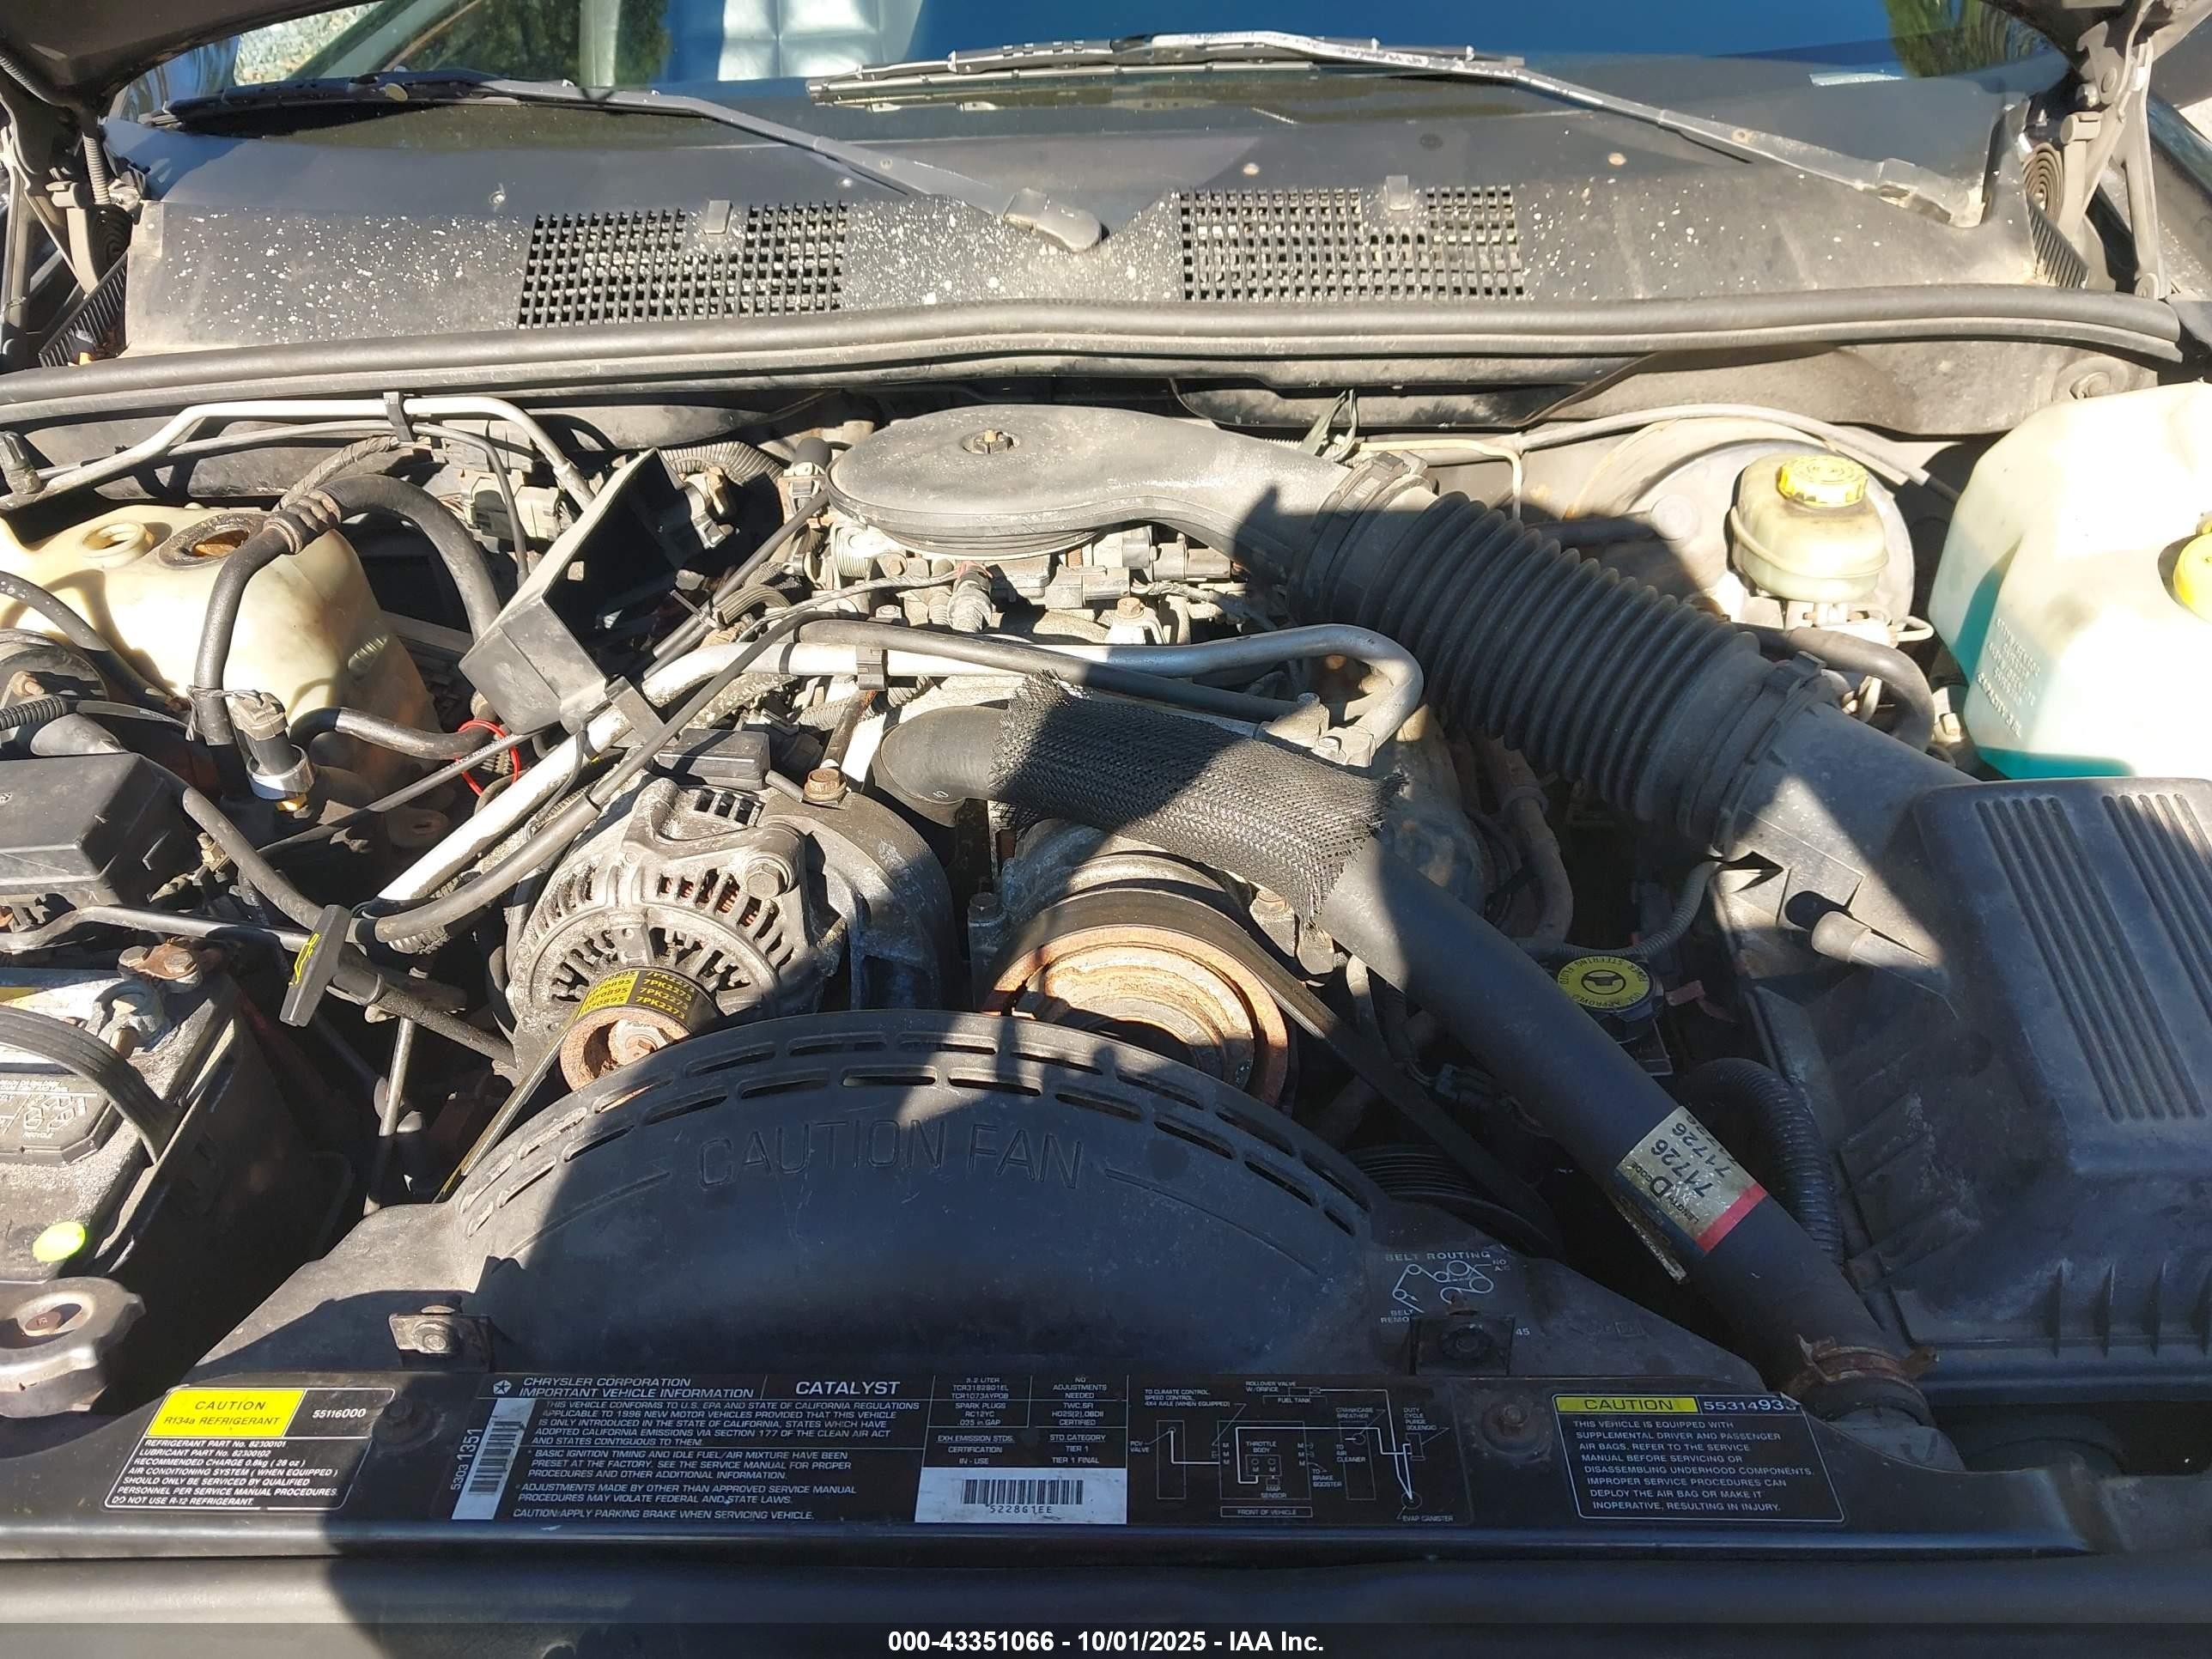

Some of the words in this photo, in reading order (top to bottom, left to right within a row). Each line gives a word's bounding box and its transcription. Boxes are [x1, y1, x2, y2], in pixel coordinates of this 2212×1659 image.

[642, 978, 692, 1001] 7PK2273
[640, 988, 689, 1011] 7PK2273
[635, 996, 686, 1019] 7PK2273
[698, 1119, 944, 1187] CAUTION
[968, 1124, 1082, 1189] FAN
[1672, 1122, 1730, 1177] 71726
[1632, 1162, 1652, 1182] CODE
[1650, 1139, 1713, 1197] 71726
[1665, 1194, 1699, 1224] LENGTH
[1427, 1251, 1491, 1260] ROUTING
[597, 1378, 691, 1387] CORPORATION
[795, 1382, 900, 1395] CATALYST
[519, 1388, 596, 1396] IMPORTANT
[603, 1389, 656, 1397] VEHICLE
[660, 1389, 754, 1398] INFORMATION
[194, 1401, 267, 1410] CAUTION
[1584, 1400, 1674, 1410] CAUTION
[312, 1407, 367, 1419] 55116000
[162, 1416, 196, 1425] R134a
[199, 1417, 280, 1425] REFRIGERANT
[456, 1429, 483, 1461] 1351
[287, 1468, 332, 1477] EQUIPPED
[450, 1462, 469, 1491] 5303
[123, 1477, 161, 1486] SHOULD
[234, 1487, 274, 1496] MANUAL
[1593, 1501, 1664, 1510] INOPERATIVE,
[1667, 1502, 1725, 1510] RESULTING
[1741, 1503, 1781, 1511] INJURY.
[595, 1510, 640, 1518] PARKING
[643, 1510, 676, 1518] BRAKE
[680, 1510, 712, 1519] WHEN
[714, 1510, 769, 1519] SERVICING
[771, 1511, 814, 1520] VEHICLE.
